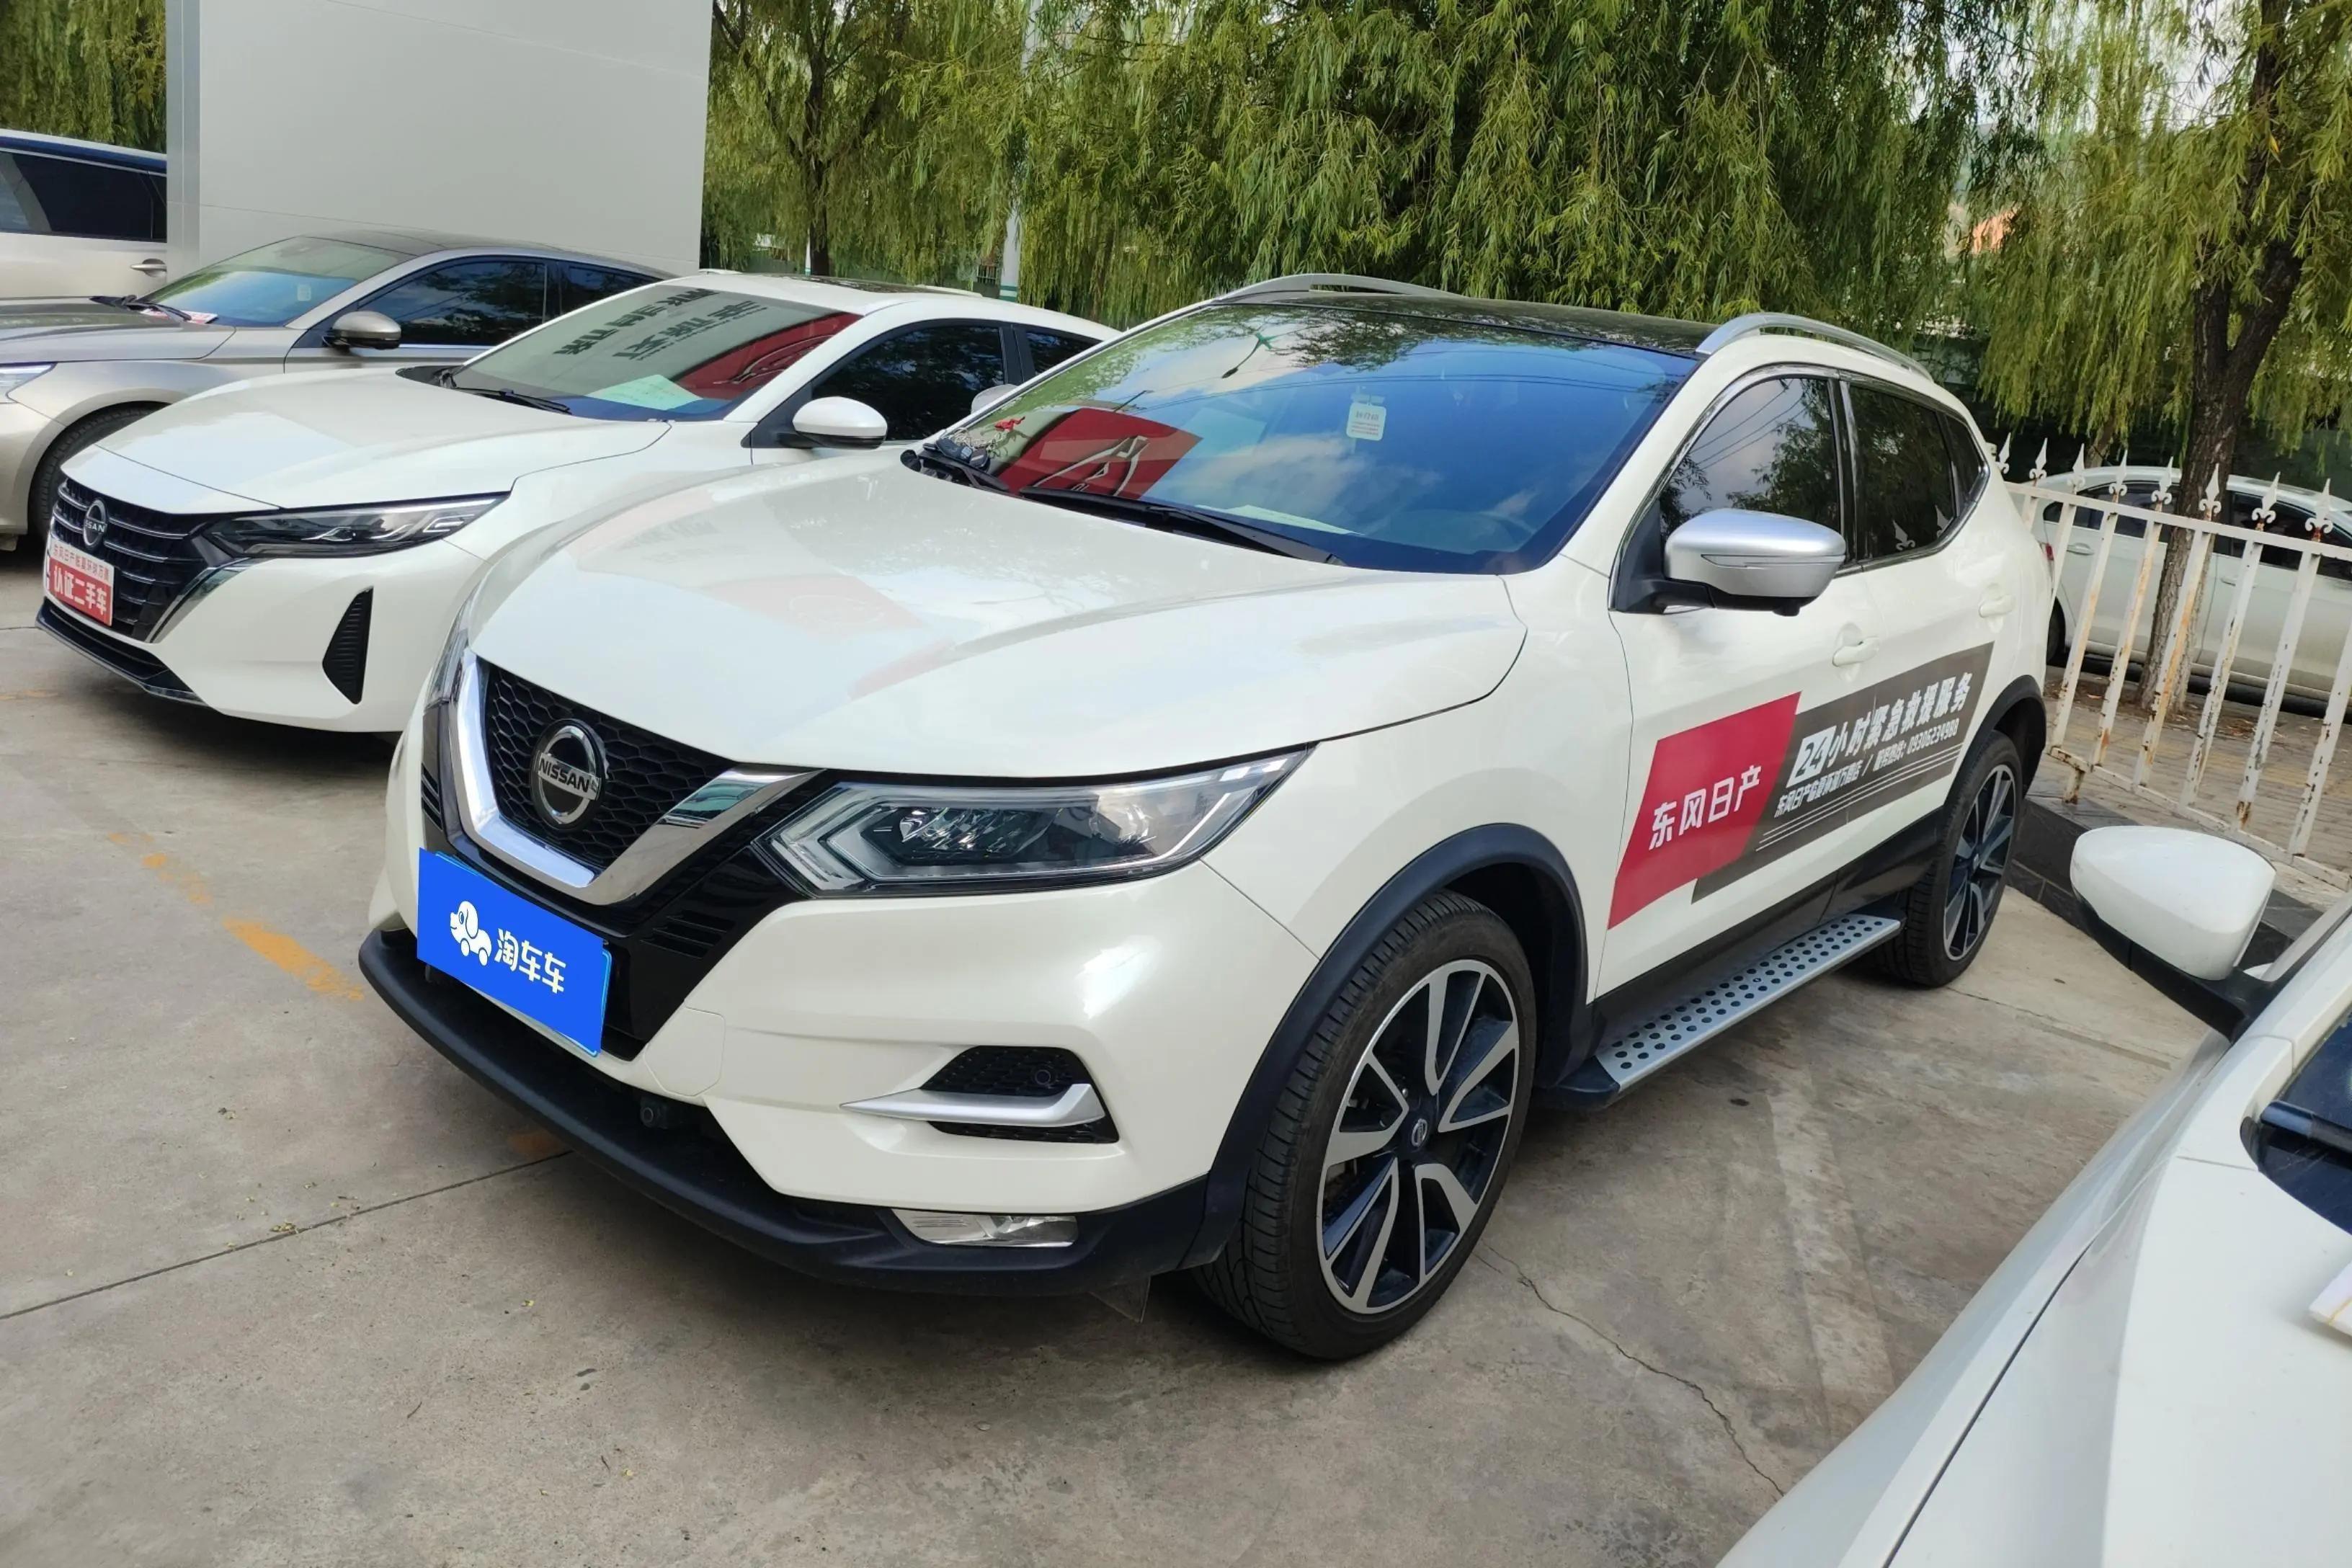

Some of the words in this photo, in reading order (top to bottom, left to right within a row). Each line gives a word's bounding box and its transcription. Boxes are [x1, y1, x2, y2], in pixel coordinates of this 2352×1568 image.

[54, 566, 107, 615] 认证二手车
[1795, 672, 1973, 777] 24小时紧急救援服务
[538, 757, 589, 792] NISSAN
[1649, 765, 1762, 850] 东风日产
